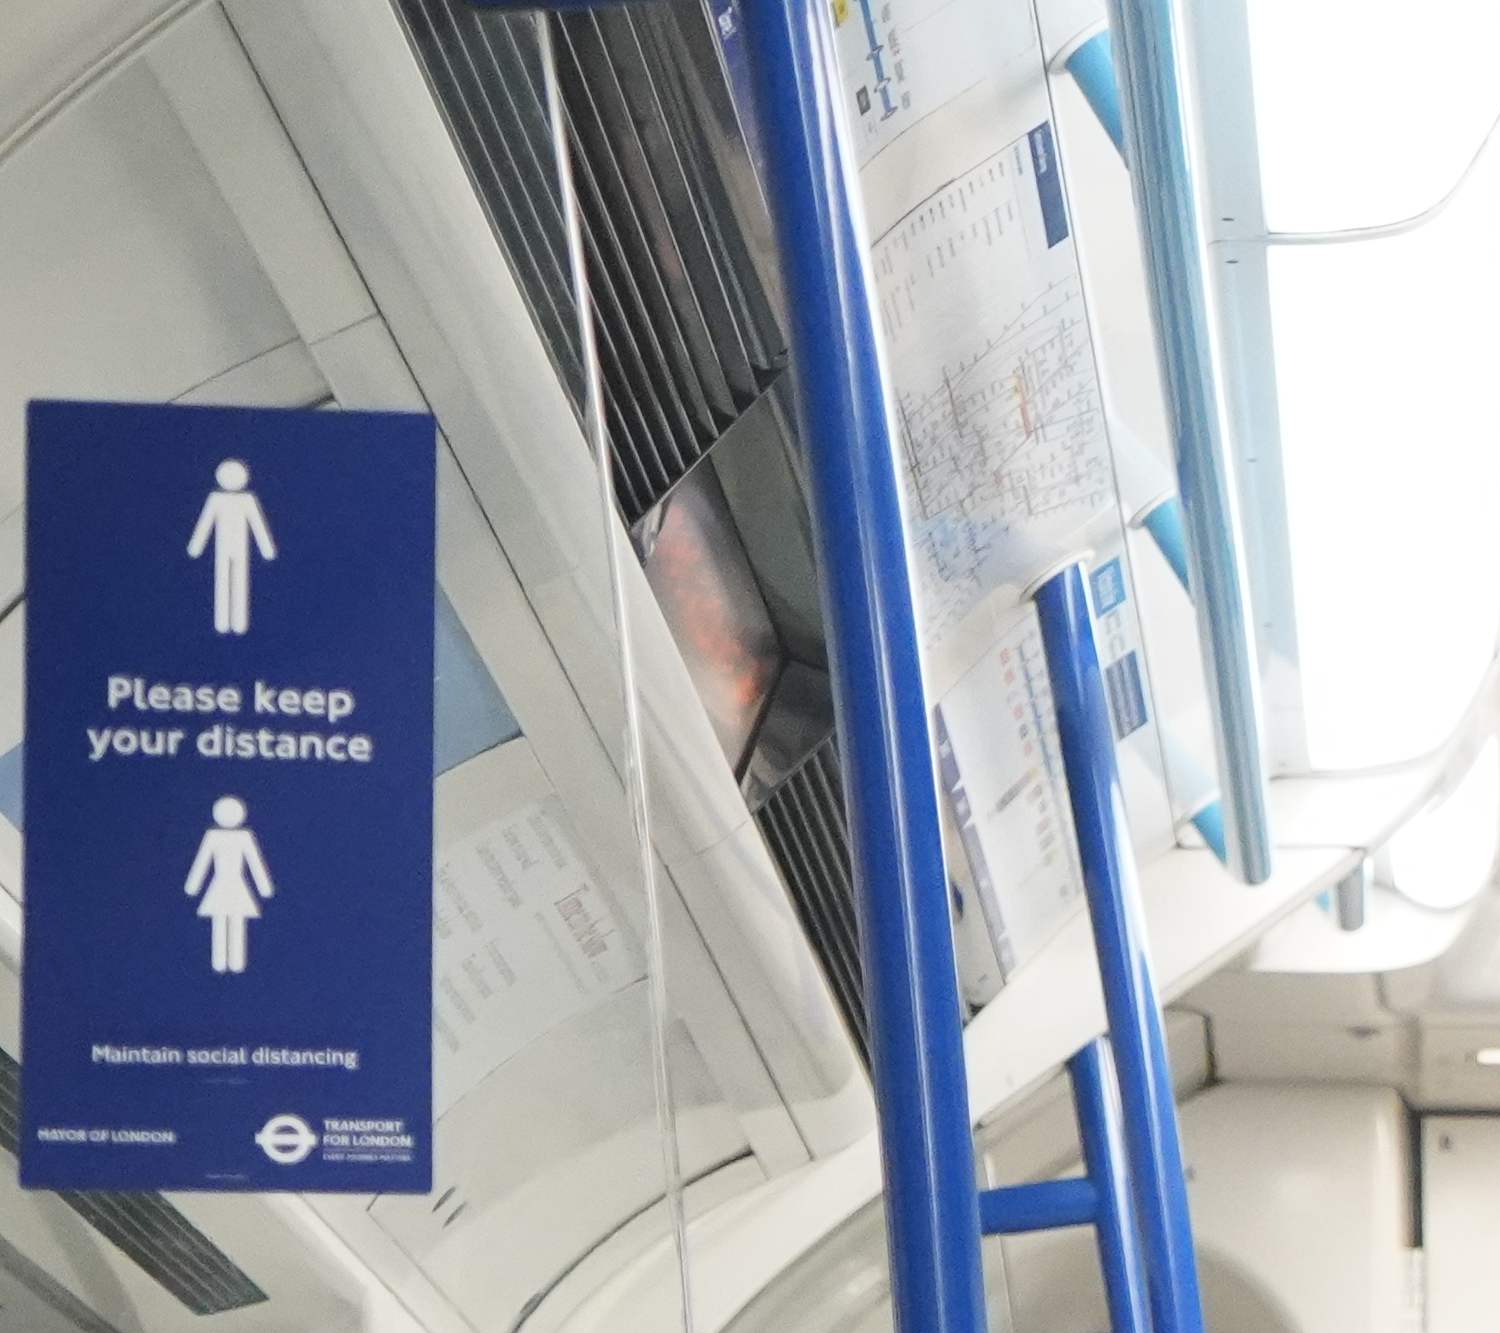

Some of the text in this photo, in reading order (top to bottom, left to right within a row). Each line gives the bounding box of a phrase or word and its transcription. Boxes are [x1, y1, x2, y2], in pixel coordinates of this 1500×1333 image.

[106, 676, 355, 723] Please keep
[86, 723, 374, 763] your distance
[91, 1044, 359, 1070] Maintain social distancing
[37, 1128, 175, 1144] MAYOR OF LONDON
[322, 1118, 404, 1134] TRANSPORT
[322, 1133, 414, 1148] FOR LONDON
